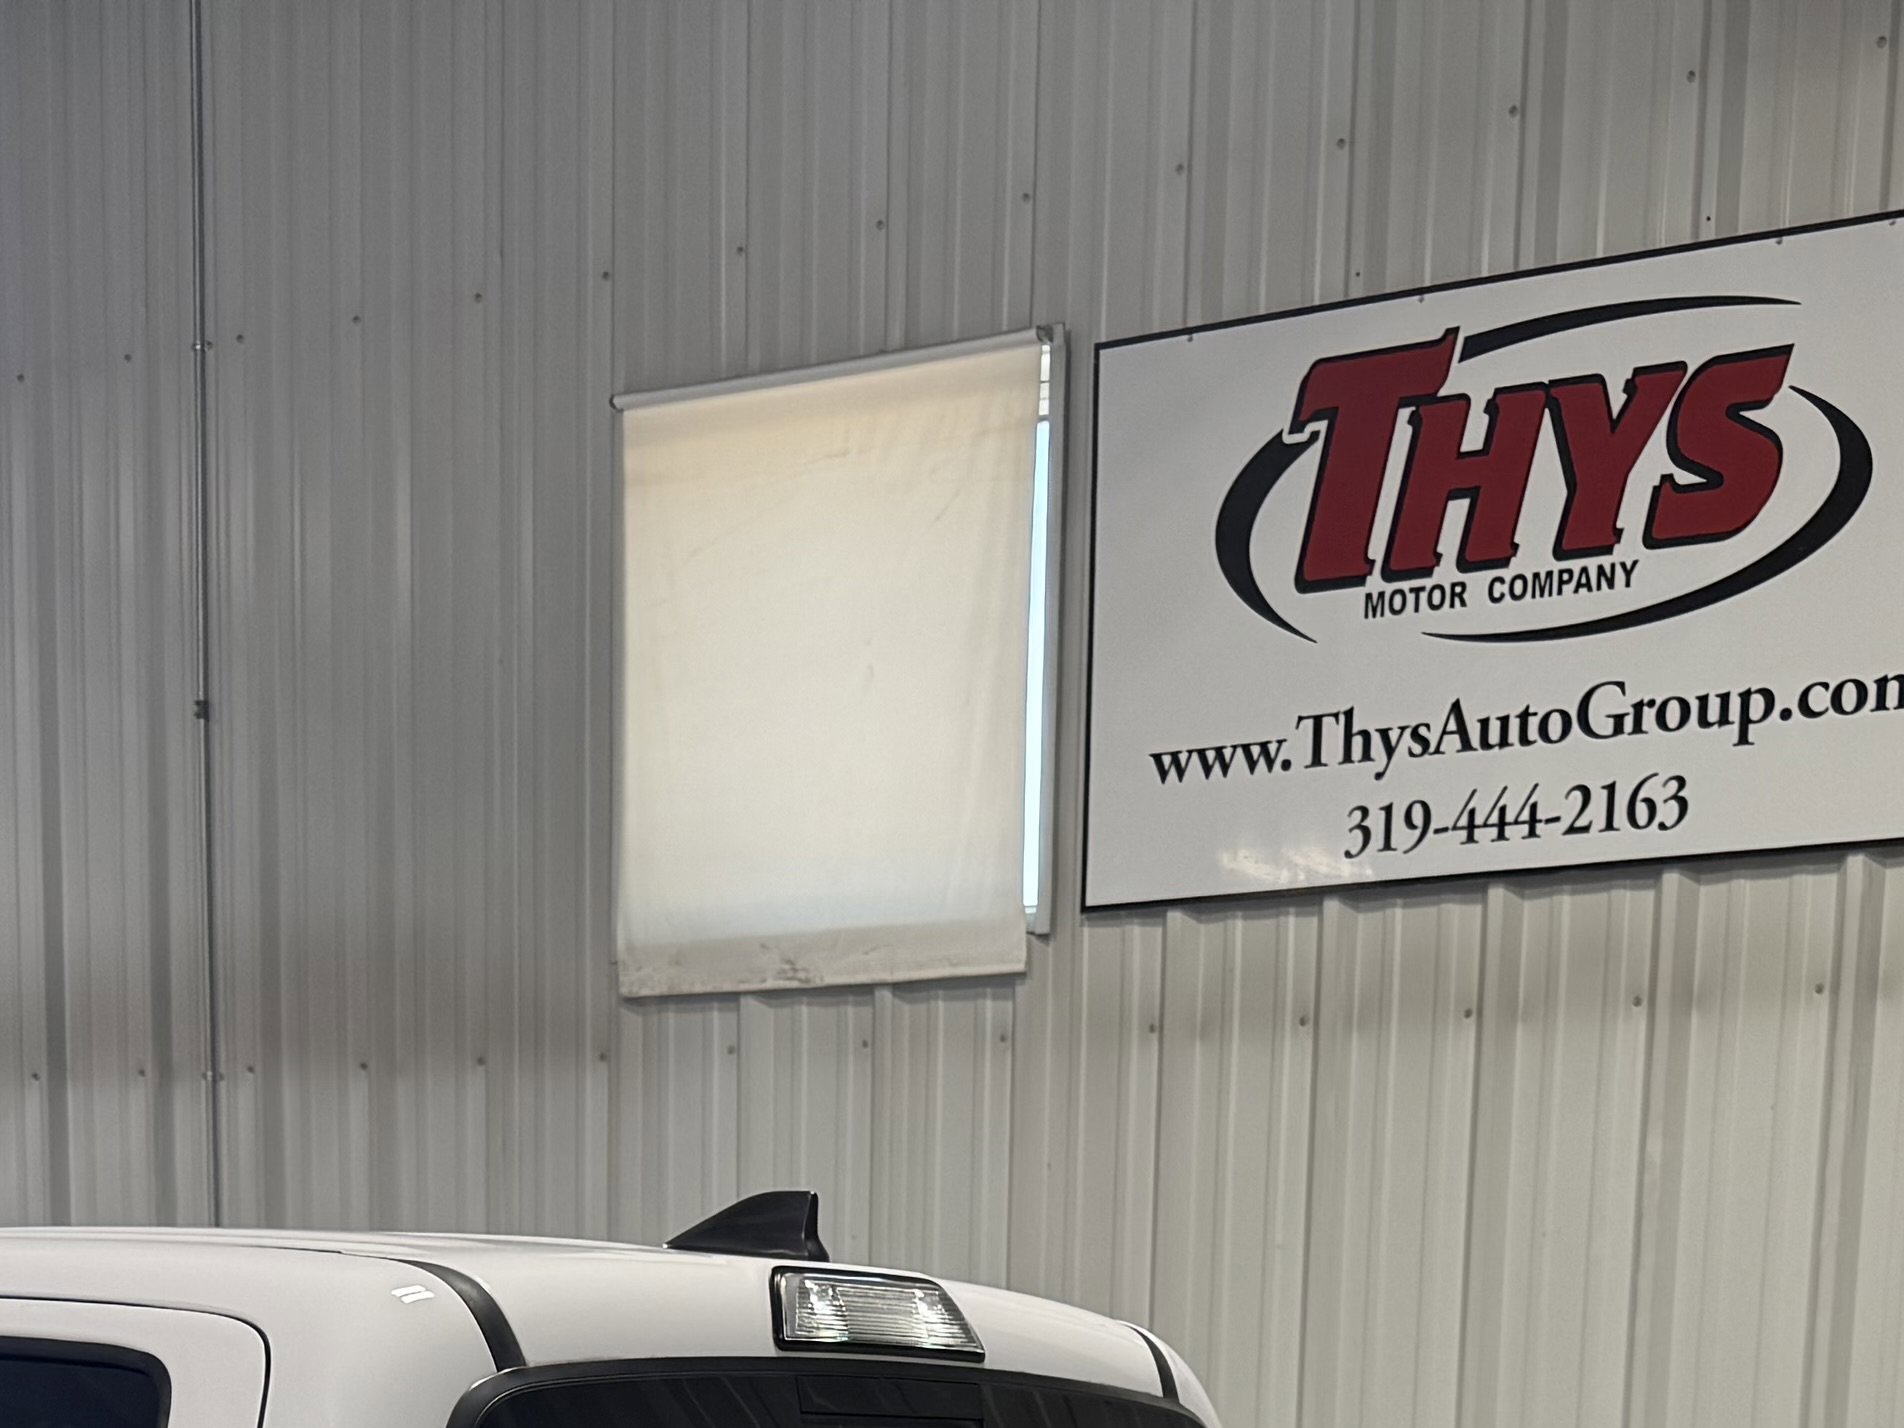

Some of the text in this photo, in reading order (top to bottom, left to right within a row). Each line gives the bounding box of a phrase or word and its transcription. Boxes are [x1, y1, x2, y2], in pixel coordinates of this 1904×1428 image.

[1286, 324, 1796, 593] THYS
[1362, 558, 1640, 619] MOTOR COMPANY
[1344, 773, 1691, 860] 319-444-2163
